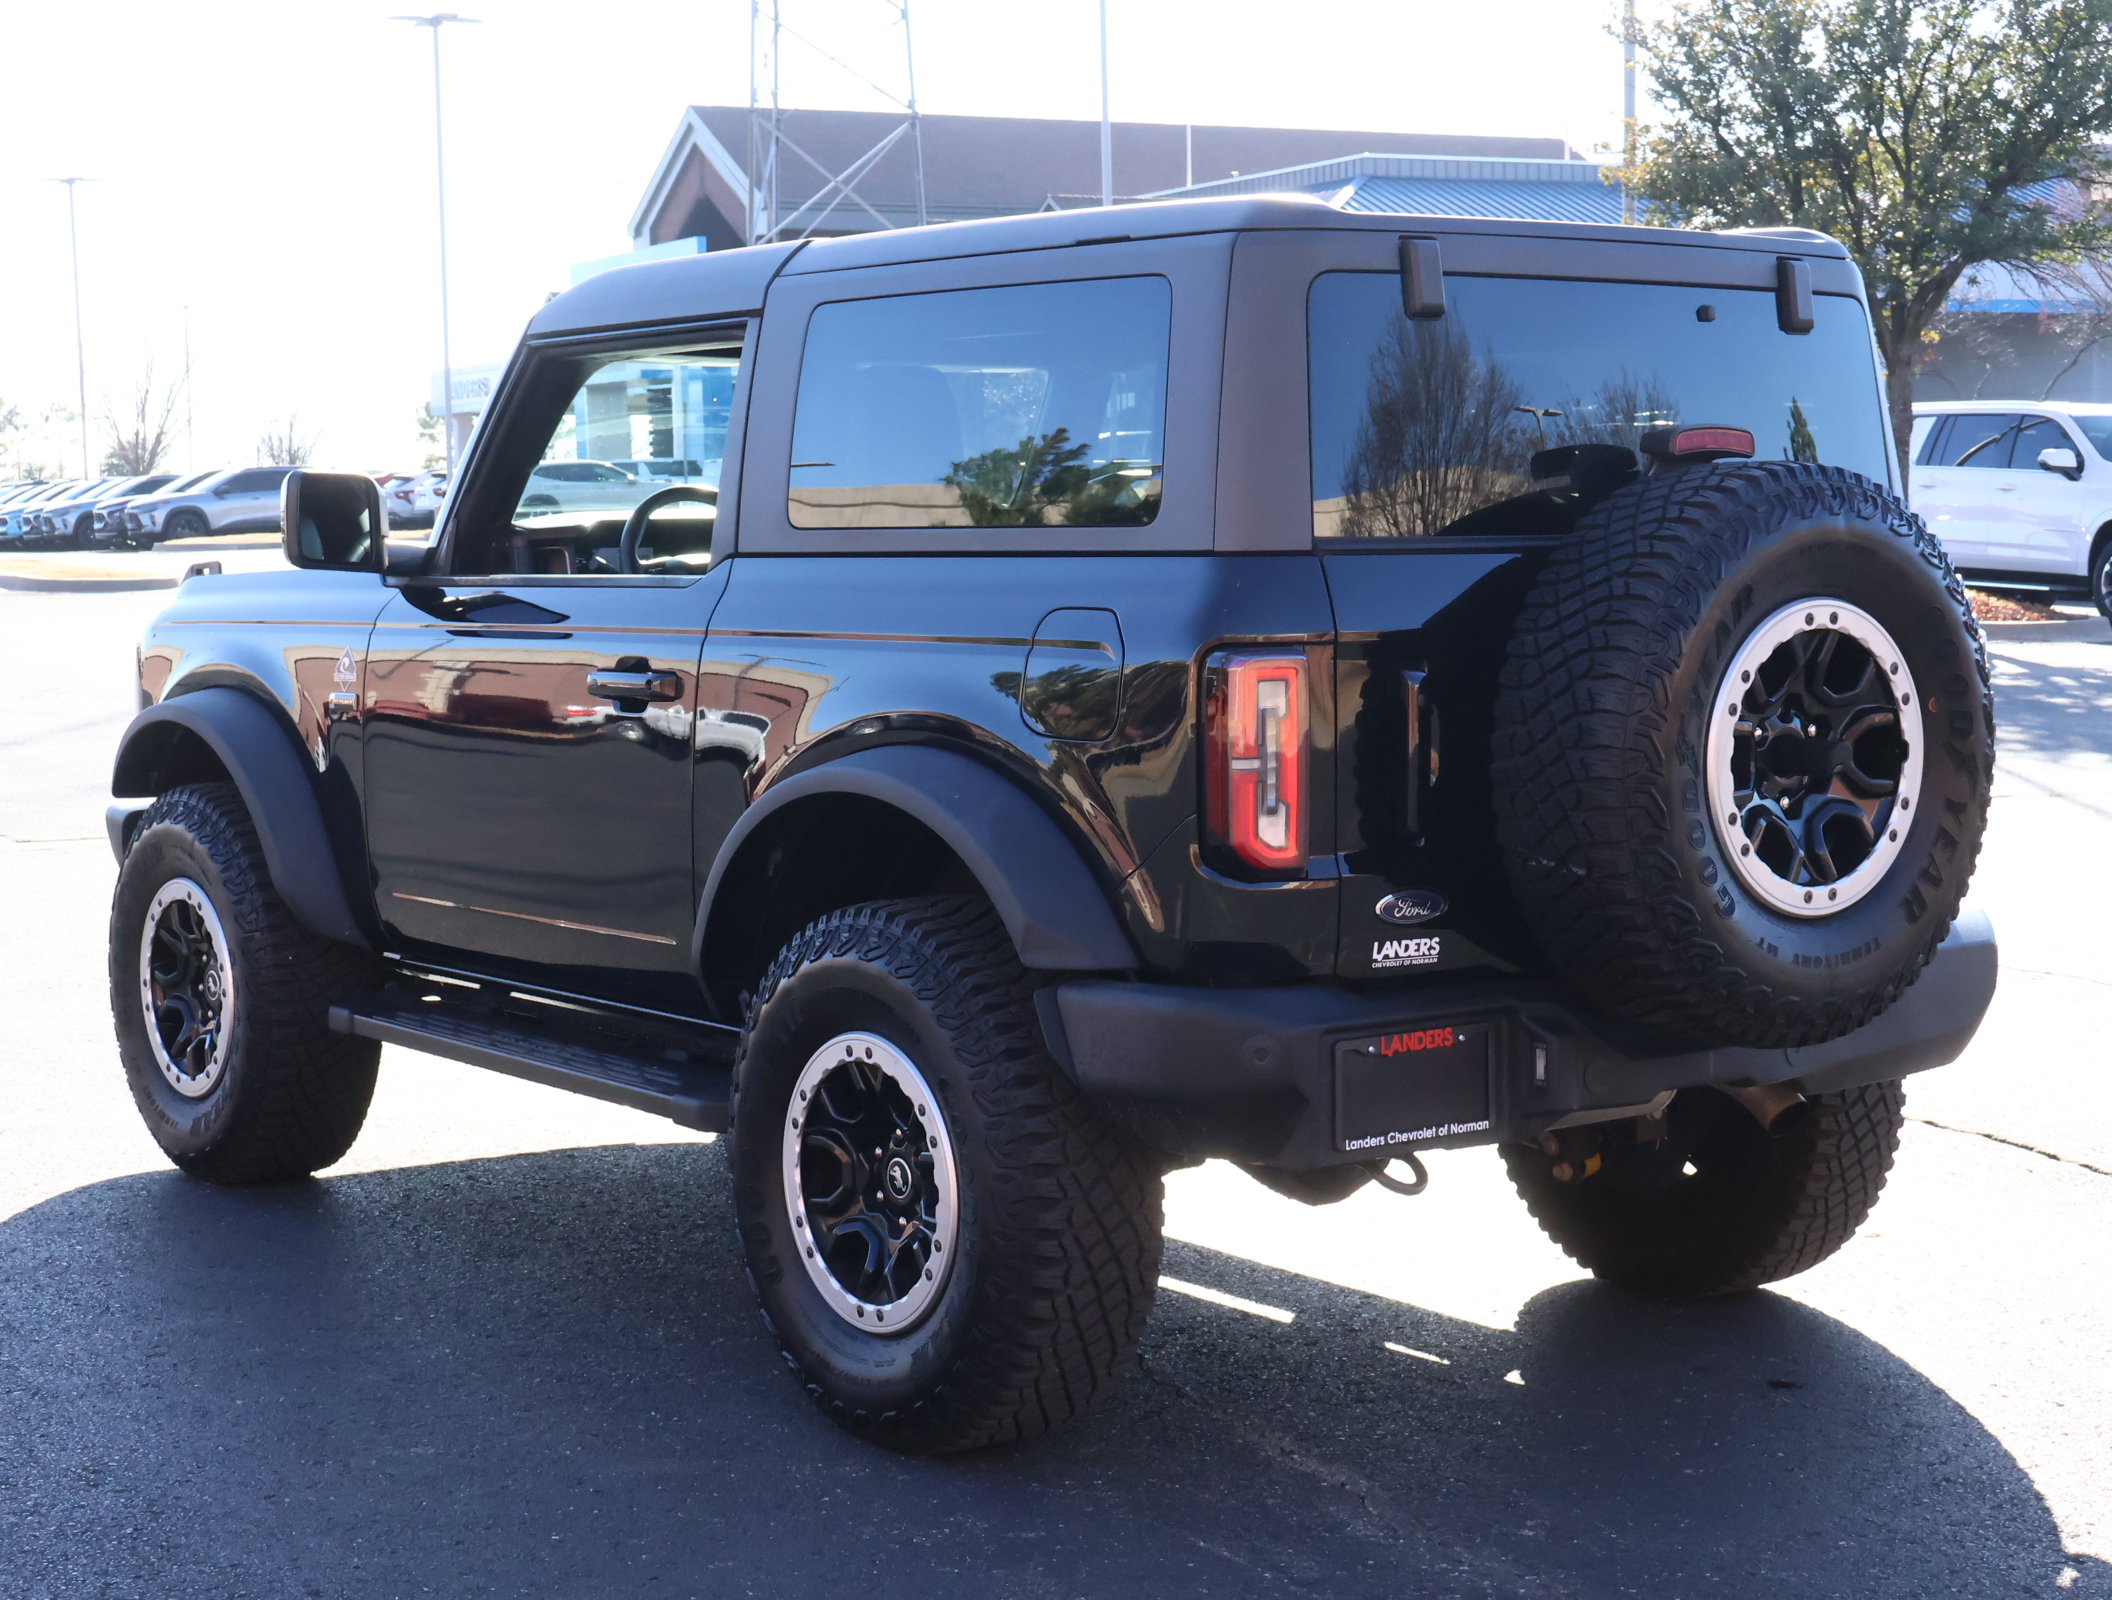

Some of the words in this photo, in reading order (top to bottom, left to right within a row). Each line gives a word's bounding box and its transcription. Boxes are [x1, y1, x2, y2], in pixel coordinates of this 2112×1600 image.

[1393, 897, 1431, 918] Ford
[1372, 936, 1440, 962] LANDERS
[1372, 960, 1402, 969] CHEVROLET
[1411, 957, 1438, 966] NORMAN
[1380, 1027, 1454, 1057] LANDERS
[1345, 1135, 1385, 1151] Landers
[1387, 1126, 1437, 1144] Chevrolet
[1438, 1124, 1449, 1137] of
[1450, 1120, 1490, 1135] Norman
